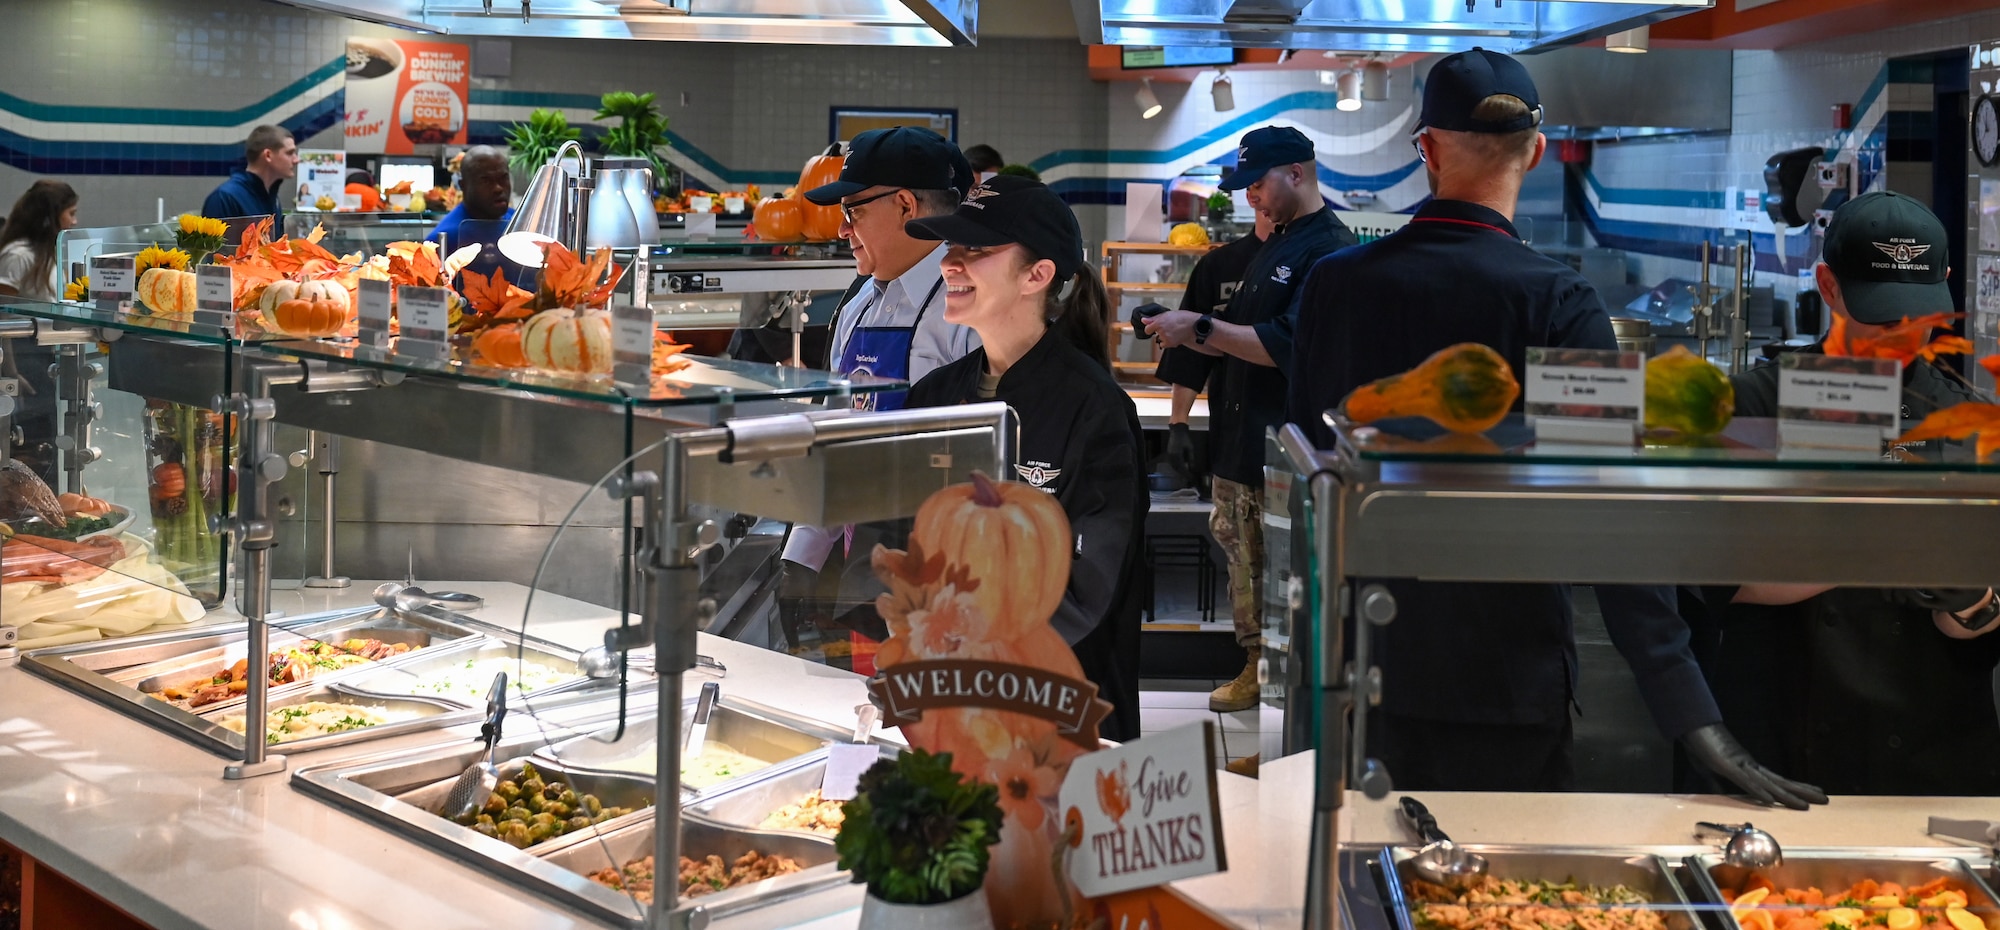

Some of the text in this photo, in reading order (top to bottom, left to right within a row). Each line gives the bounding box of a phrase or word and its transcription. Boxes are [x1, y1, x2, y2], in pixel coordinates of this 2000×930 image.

[410, 57, 465, 71] DUNKIN'
[410, 69, 465, 83] BREWIN'
[414, 107, 449, 119] COLD
[1898, 263, 1930, 271] BEVERAGE
[893, 669, 1079, 715] WELCOME
[1133, 755, 1192, 818] Give
[1092, 813, 1206, 878] THANKS
